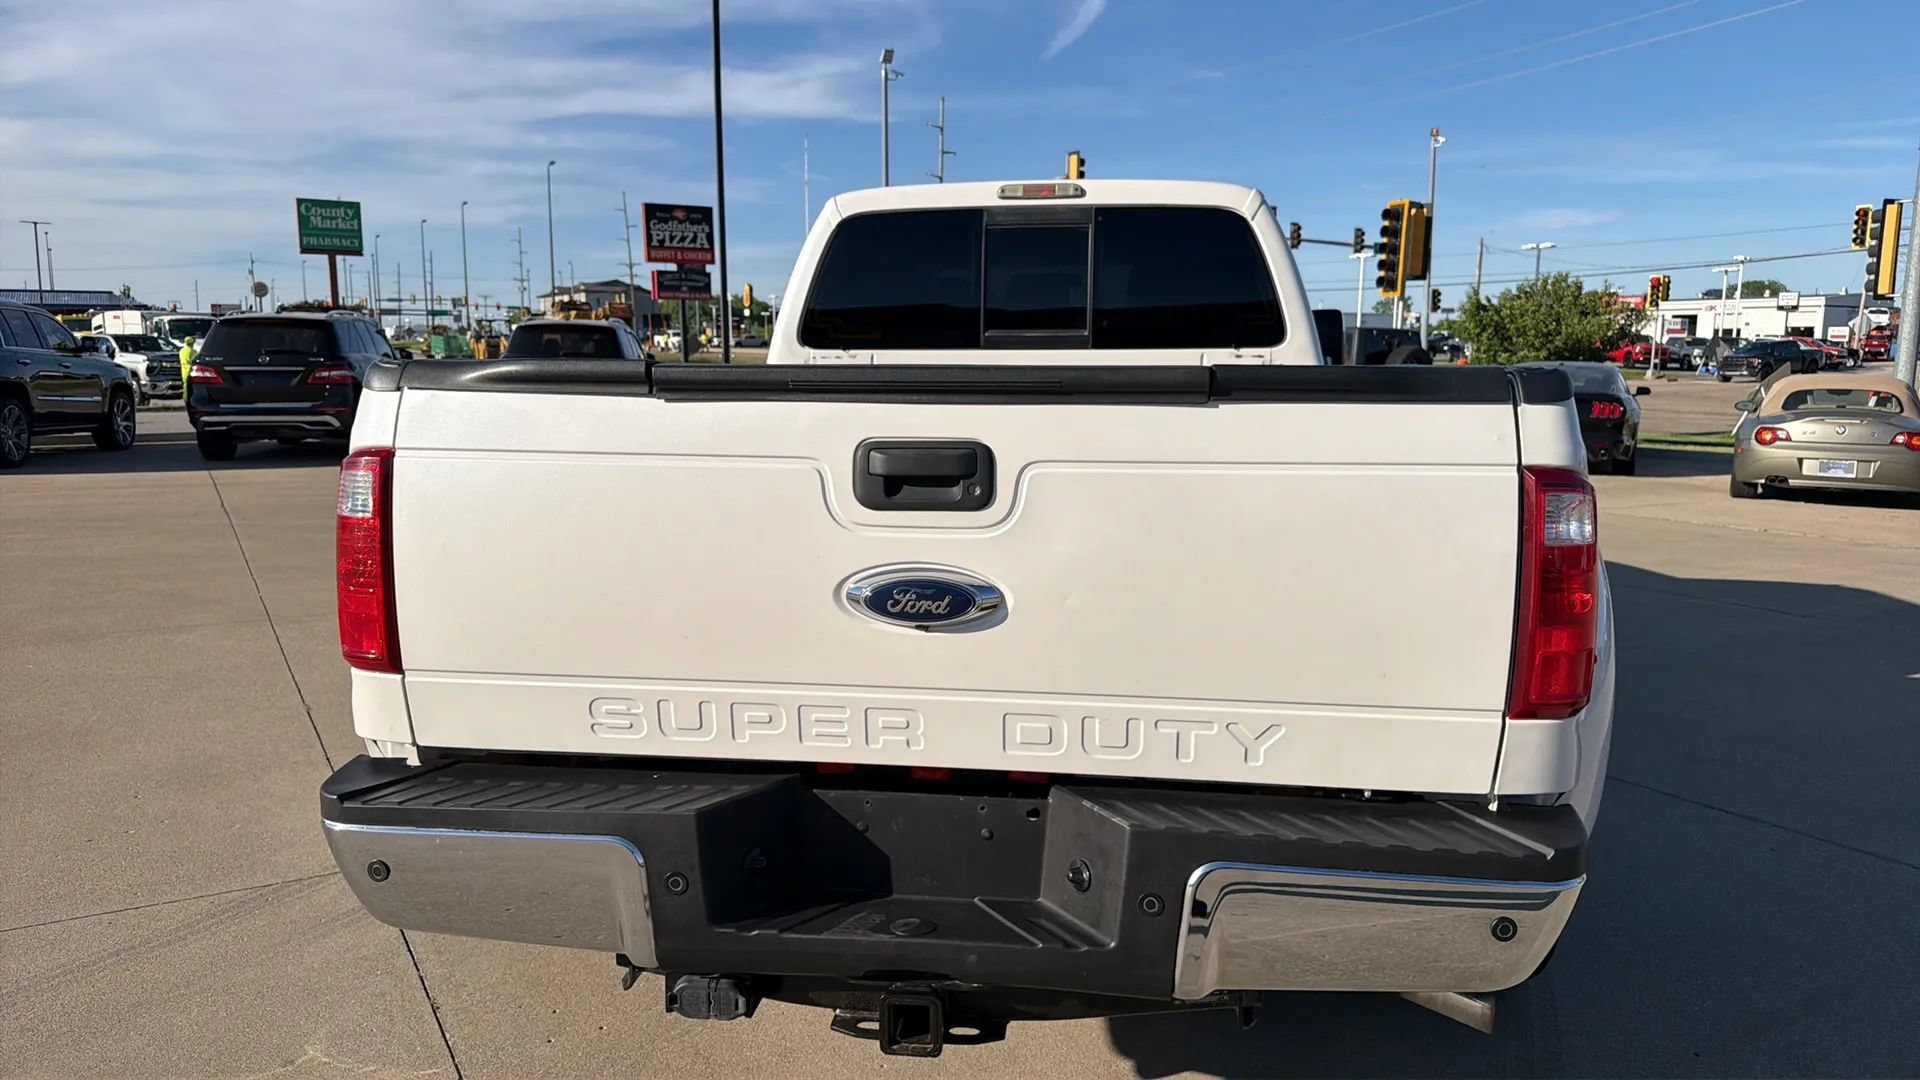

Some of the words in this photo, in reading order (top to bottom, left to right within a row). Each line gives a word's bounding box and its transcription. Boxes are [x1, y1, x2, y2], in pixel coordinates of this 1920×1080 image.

[300, 203, 355, 219] County
[310, 216, 358, 230] Market
[649, 220, 710, 233] Godfather's
[303, 236, 359, 247] PHARMACY
[650, 231, 710, 248] PIZZA
[887, 587, 952, 614] Ford
[588, 697, 926, 750] SUPER
[1002, 712, 1286, 766] DUTY
